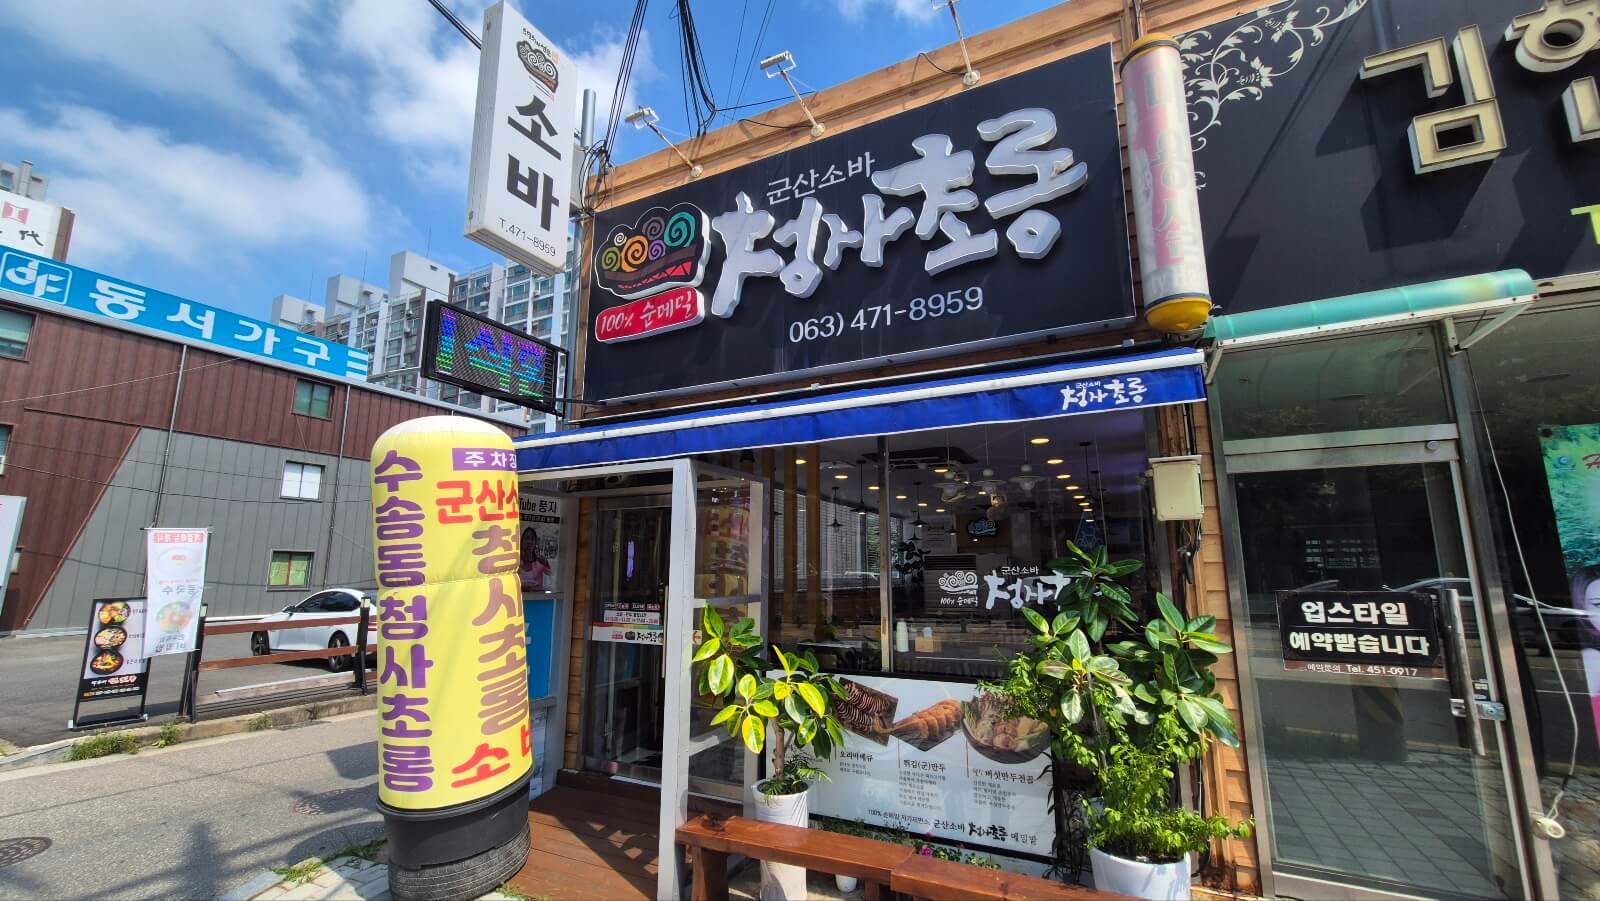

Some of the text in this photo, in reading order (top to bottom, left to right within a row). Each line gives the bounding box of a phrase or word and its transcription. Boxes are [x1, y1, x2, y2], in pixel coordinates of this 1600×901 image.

[507, 95, 561, 231] 소바
[766, 151, 877, 206] 군산소바
[711, 107, 1089, 319] 청사초롱
[500, 217, 556, 257] T.471-8959
[89, 278, 331, 367] 동서가구
[601, 312, 635, 335] 100%
[789, 286, 984, 343] 063) 471-8959
[1061, 377, 1148, 410] 청사초롱
[1001, 566, 1040, 576] 군산소바
[1301, 600, 1409, 626] 업스타일
[1289, 630, 1430, 657] 예약받습니다
[1346, 664, 1365, 674] Tel.
[1366, 664, 1418, 677] 451-0917
